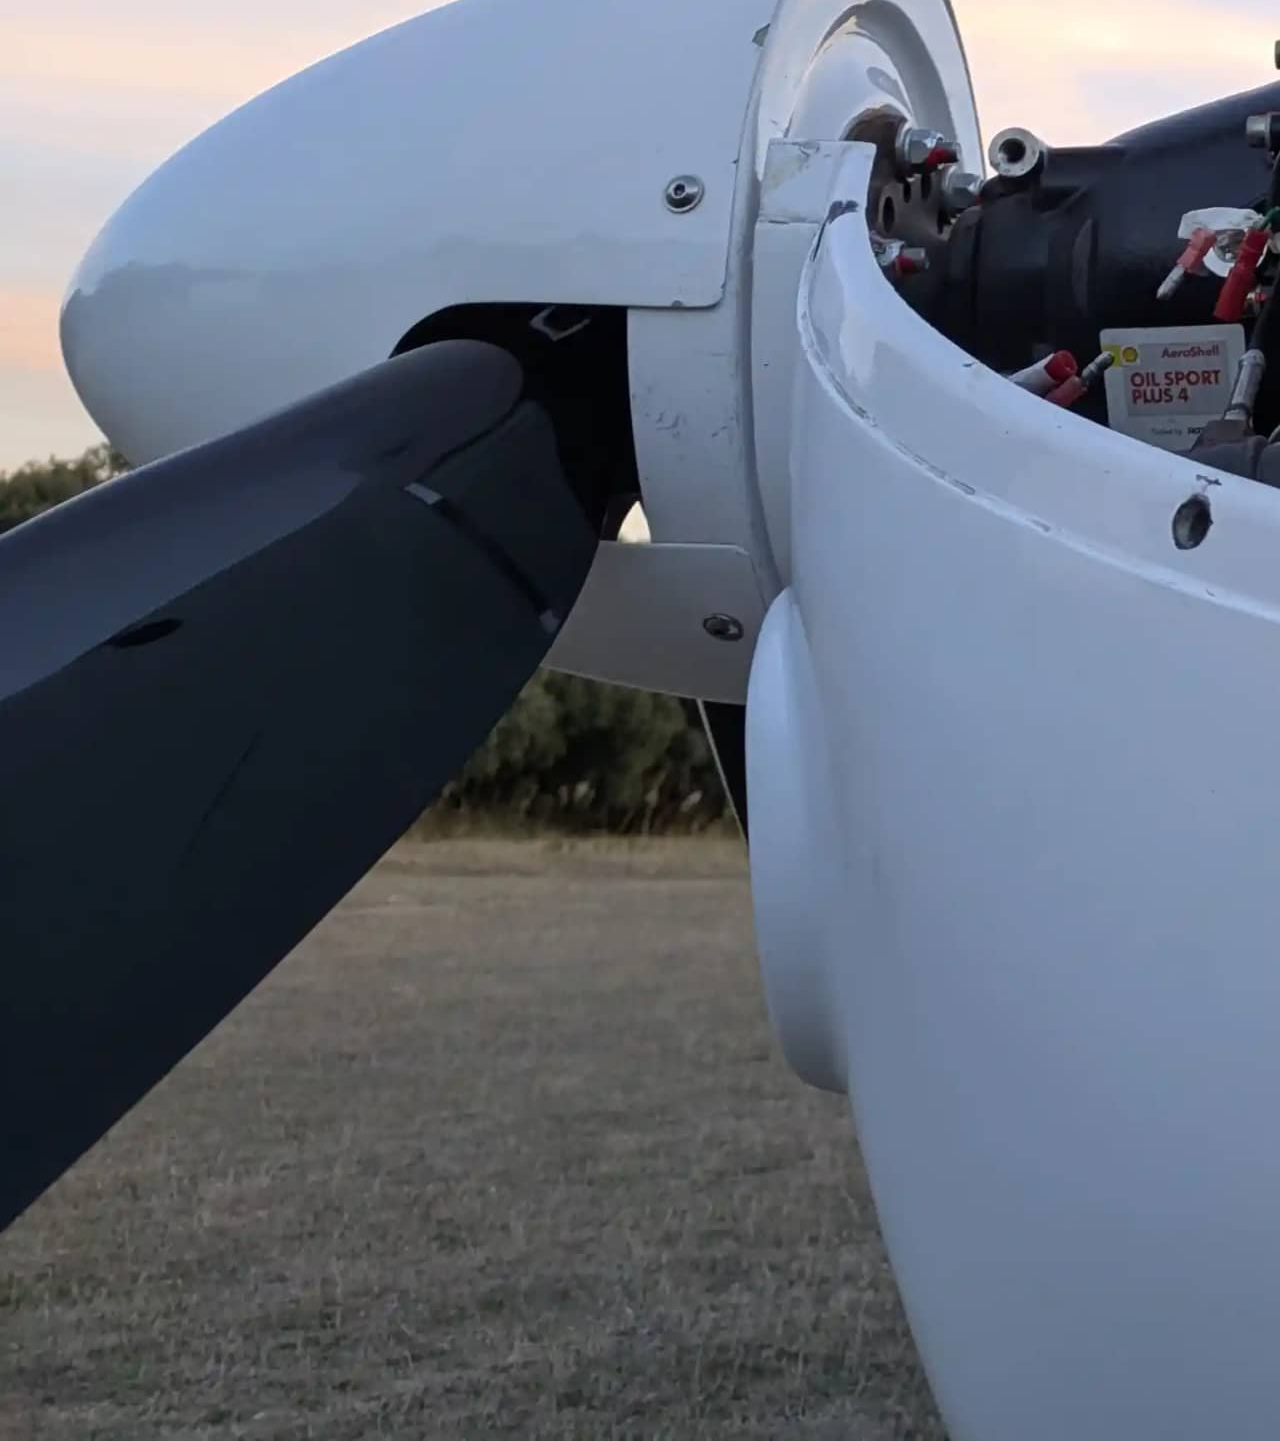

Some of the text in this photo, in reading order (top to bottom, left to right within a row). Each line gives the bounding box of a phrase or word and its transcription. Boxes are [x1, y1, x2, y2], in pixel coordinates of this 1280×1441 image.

[1161, 344, 1220, 359] AeroShell
[1130, 369, 1221, 388] OIL SPORT
[1132, 387, 1189, 405] PLUS 4
